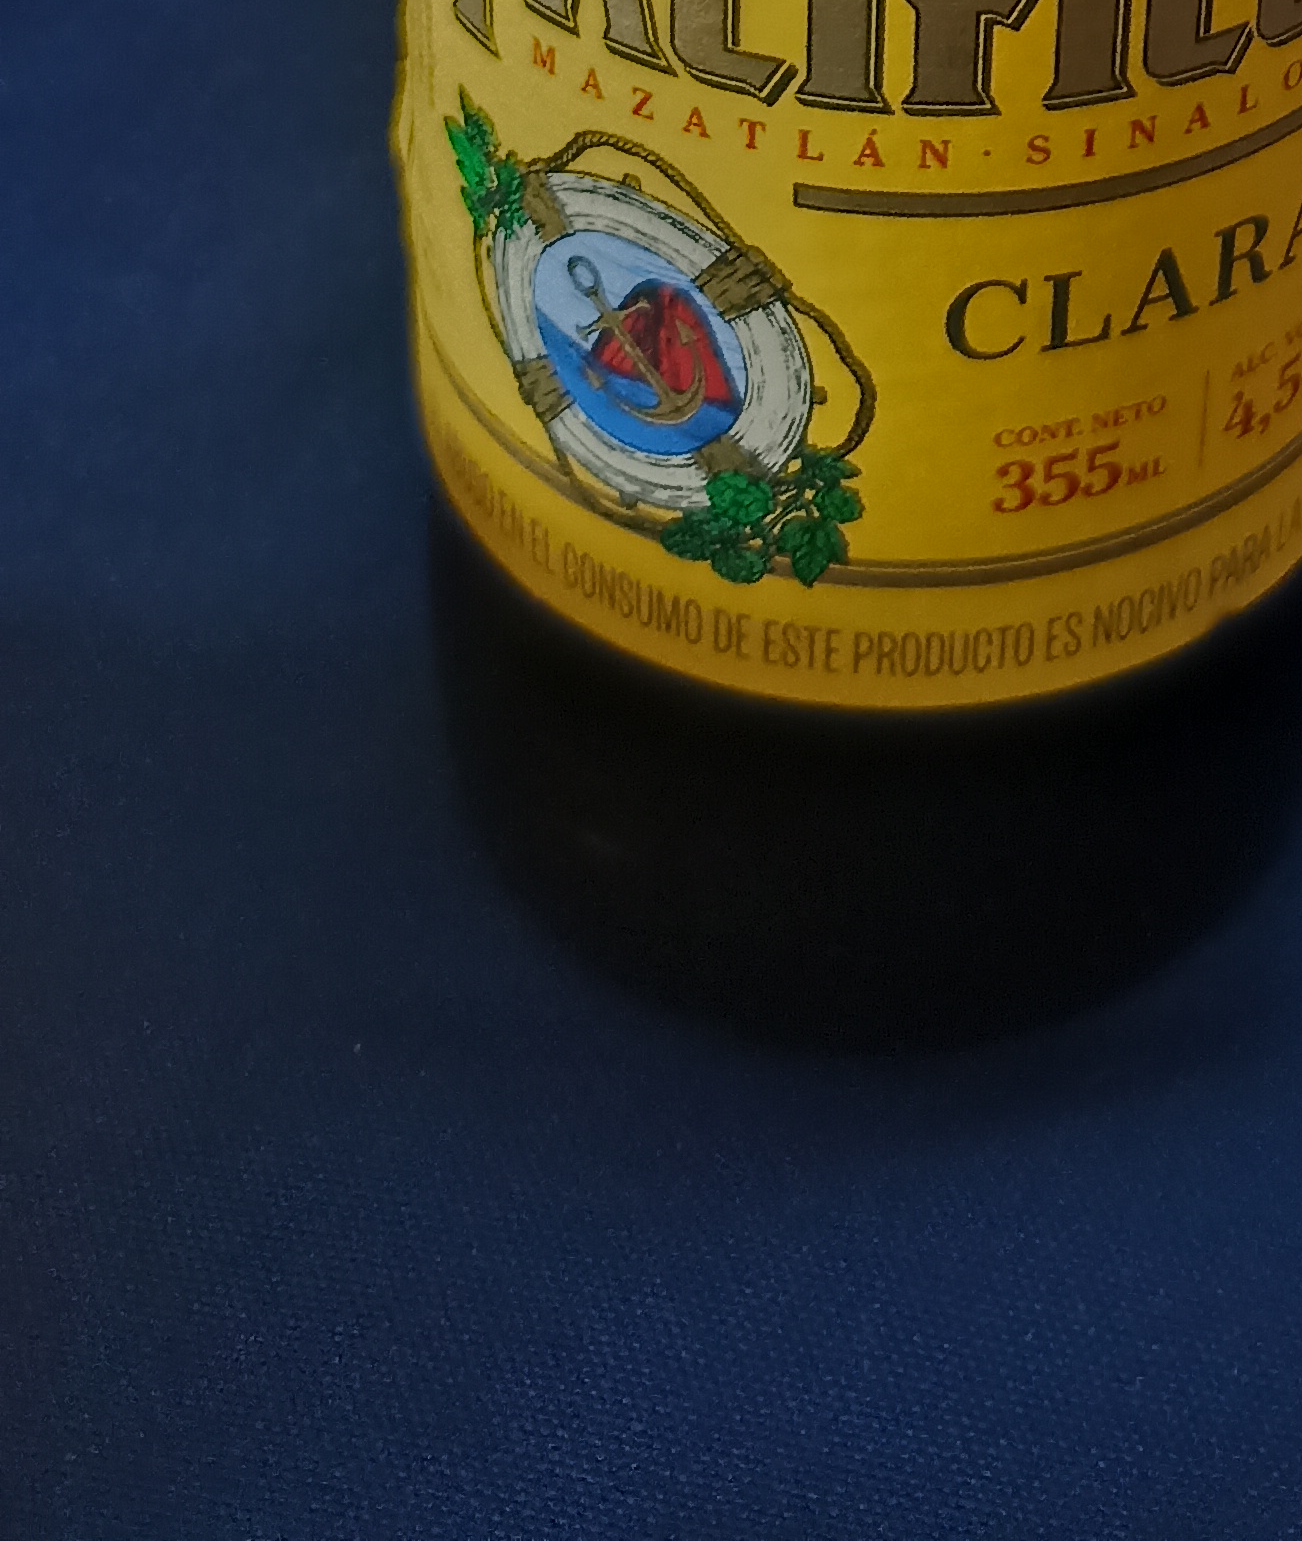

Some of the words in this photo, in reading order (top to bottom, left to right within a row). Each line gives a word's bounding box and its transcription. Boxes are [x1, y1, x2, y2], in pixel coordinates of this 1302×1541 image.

[532, 36, 951, 170] MAZATLÁN
[992, 416, 1084, 450] CONT.
[1090, 394, 1168, 433] NETO
[562, 539, 703, 645] CONSUMO
[712, 604, 752, 658] DE
[762, 620, 842, 674] ESTE
[853, 620, 1034, 678] PRODUCTO
[1045, 610, 1083, 663] ES
[1091, 569, 1202, 650] NOCIVO
